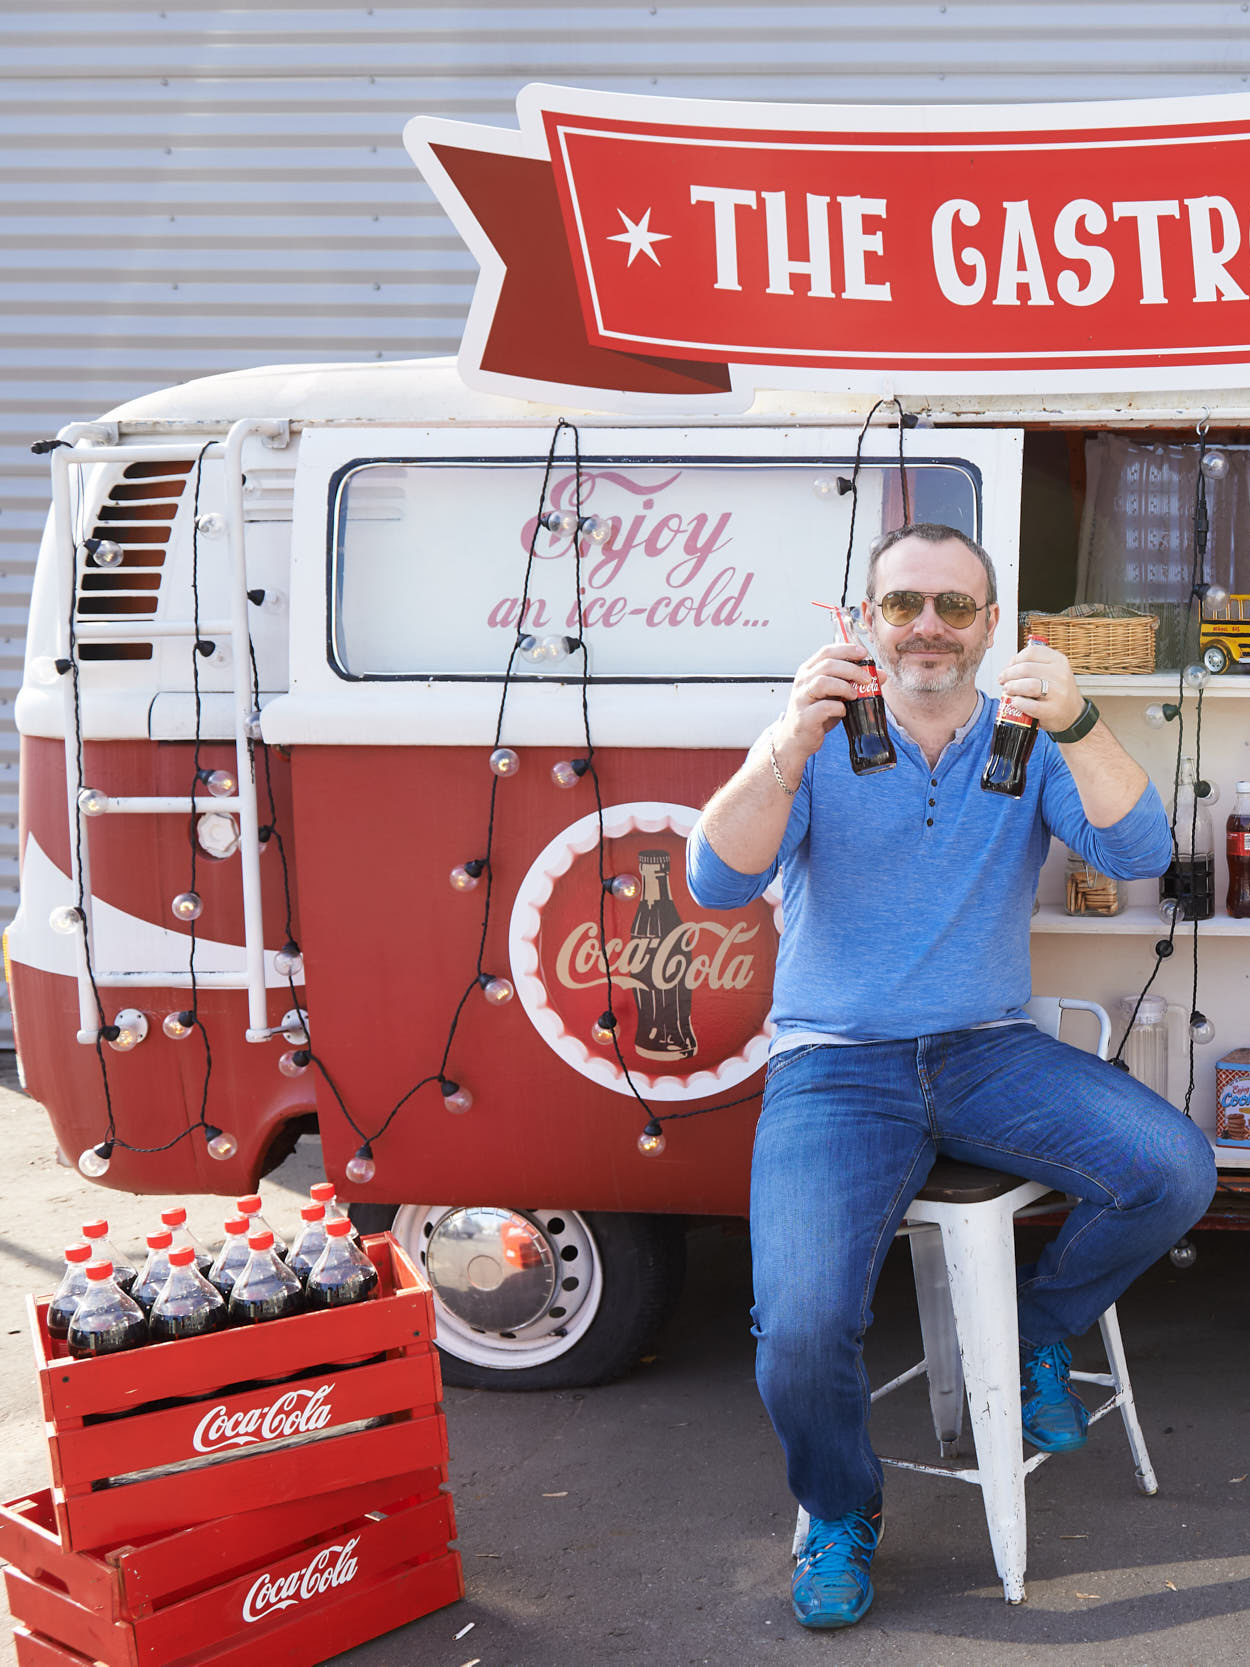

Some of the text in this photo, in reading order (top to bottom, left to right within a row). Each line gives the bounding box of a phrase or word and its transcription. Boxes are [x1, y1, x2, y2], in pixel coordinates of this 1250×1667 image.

[689, 184, 892, 302] THE
[487, 566, 770, 629] an ice-cold...
[555, 921, 761, 991] Coca-Cola
[193, 1382, 336, 1453] Coca-Cola
[242, 1535, 361, 1623] Coca-Cola
